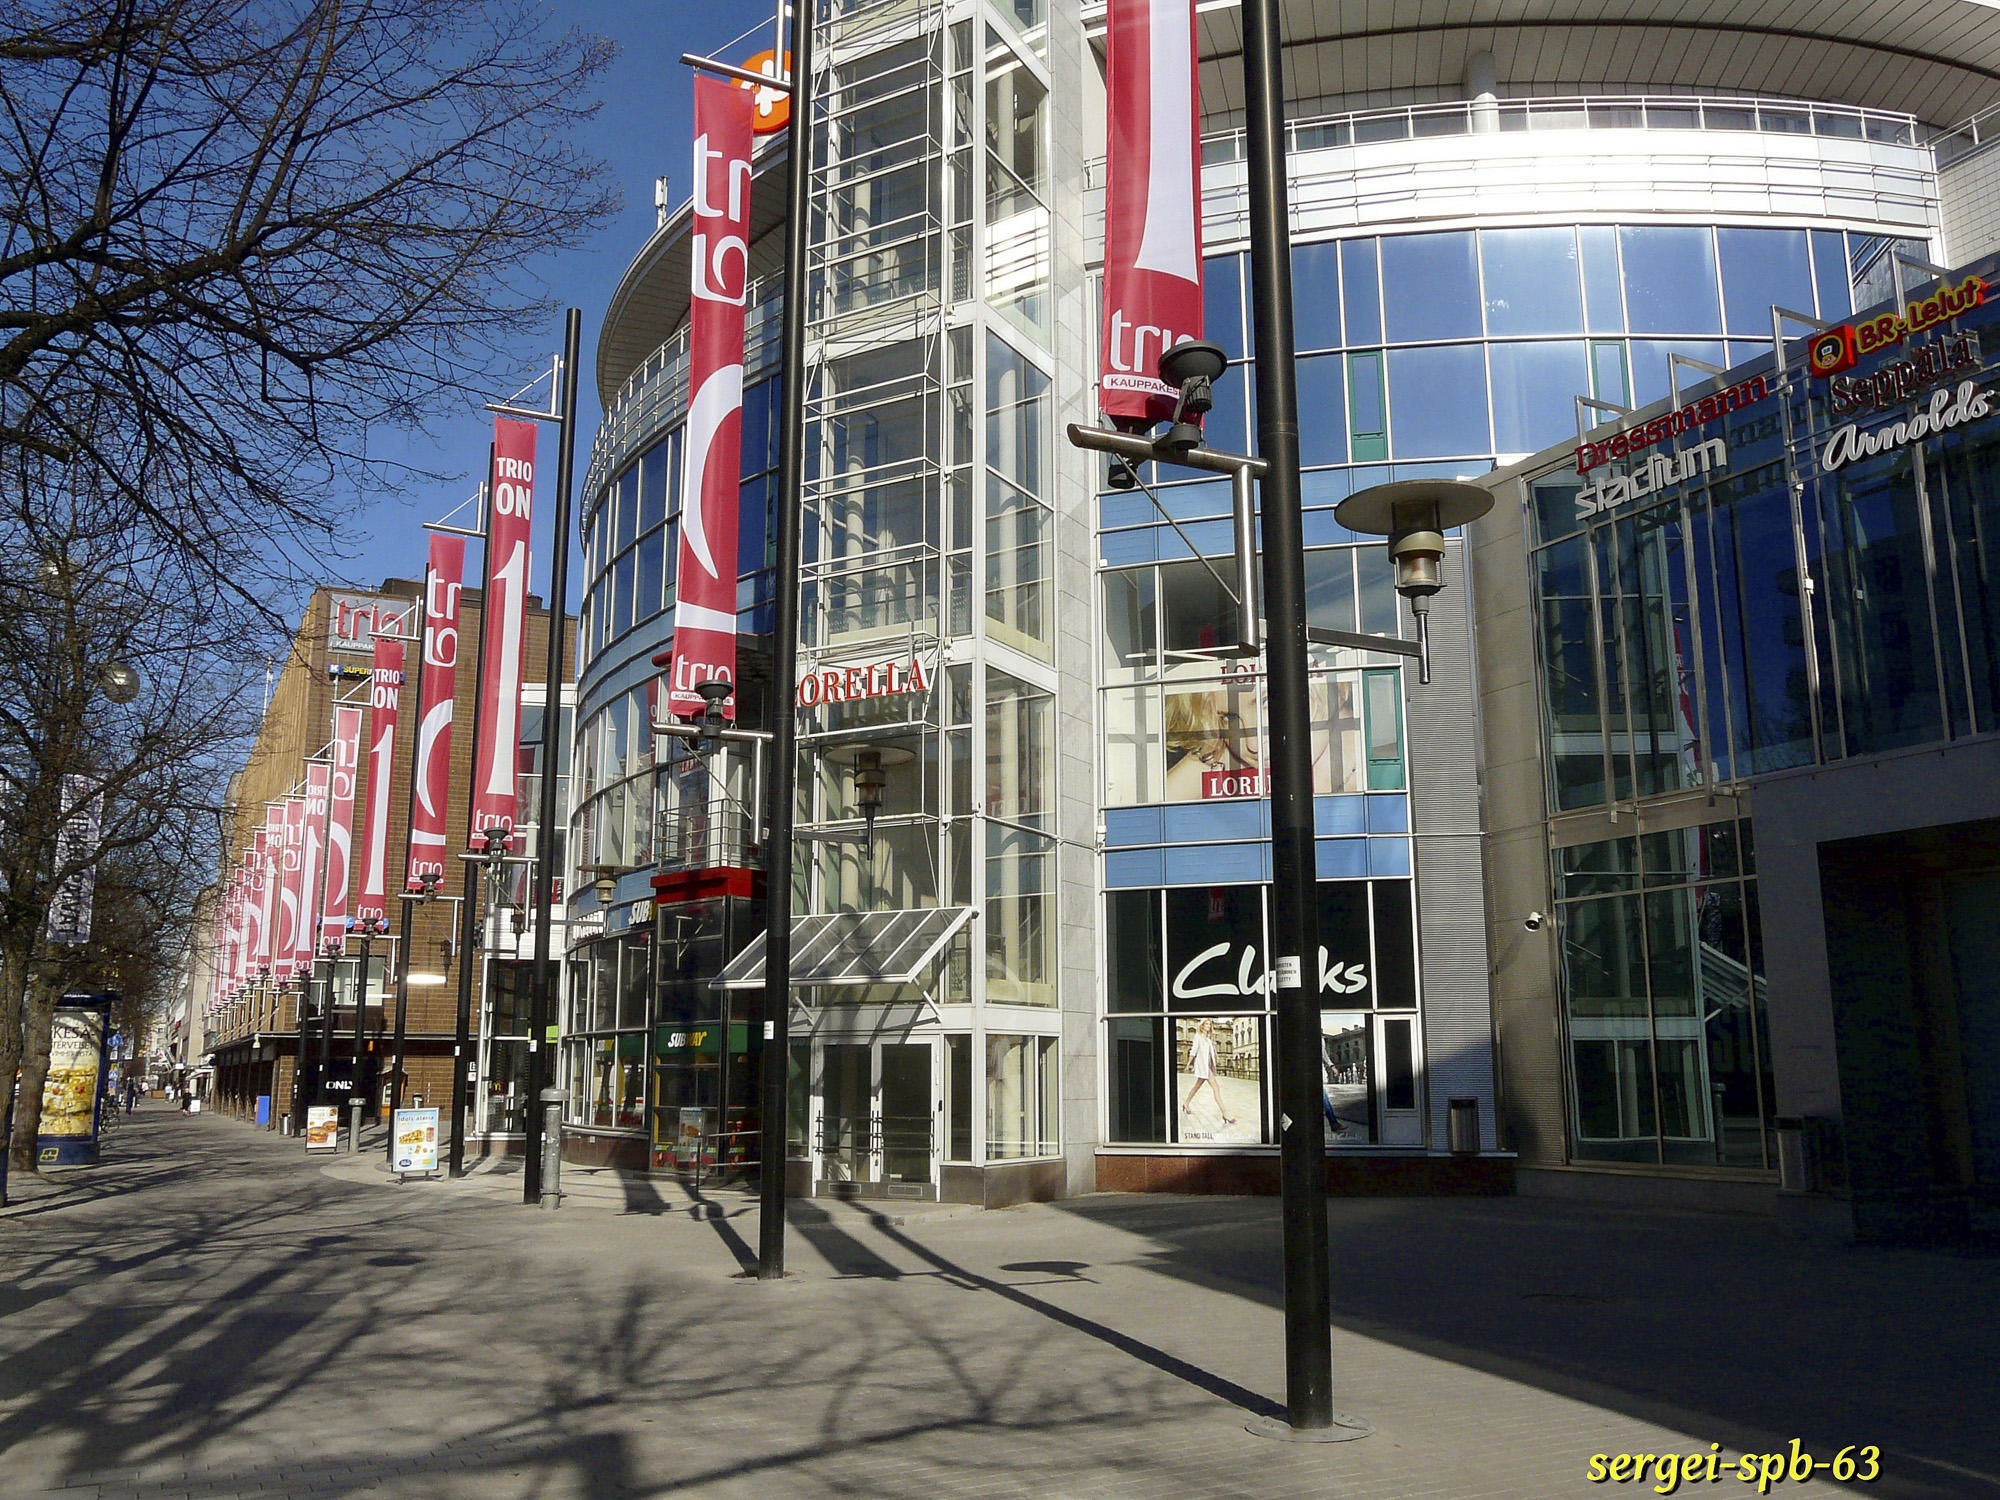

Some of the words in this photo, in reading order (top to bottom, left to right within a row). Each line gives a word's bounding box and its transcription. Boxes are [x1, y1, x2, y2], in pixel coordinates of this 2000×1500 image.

[1574, 375, 1769, 475] Dressmann
[1822, 380, 1991, 472] Arnolds
[496, 457, 532, 482] TRIO
[495, 484, 531, 520] ON
[336, 600, 403, 641] trio
[336, 640, 374, 650] KAUPPAK
[343, 666, 372, 675] SUPER
[374, 668, 400, 684] TRIO
[795, 658, 927, 707] ORELLA
[373, 685, 398, 711] ON
[357, 903, 383, 920] trio
[667, 1031, 707, 1048] SUBWAY
